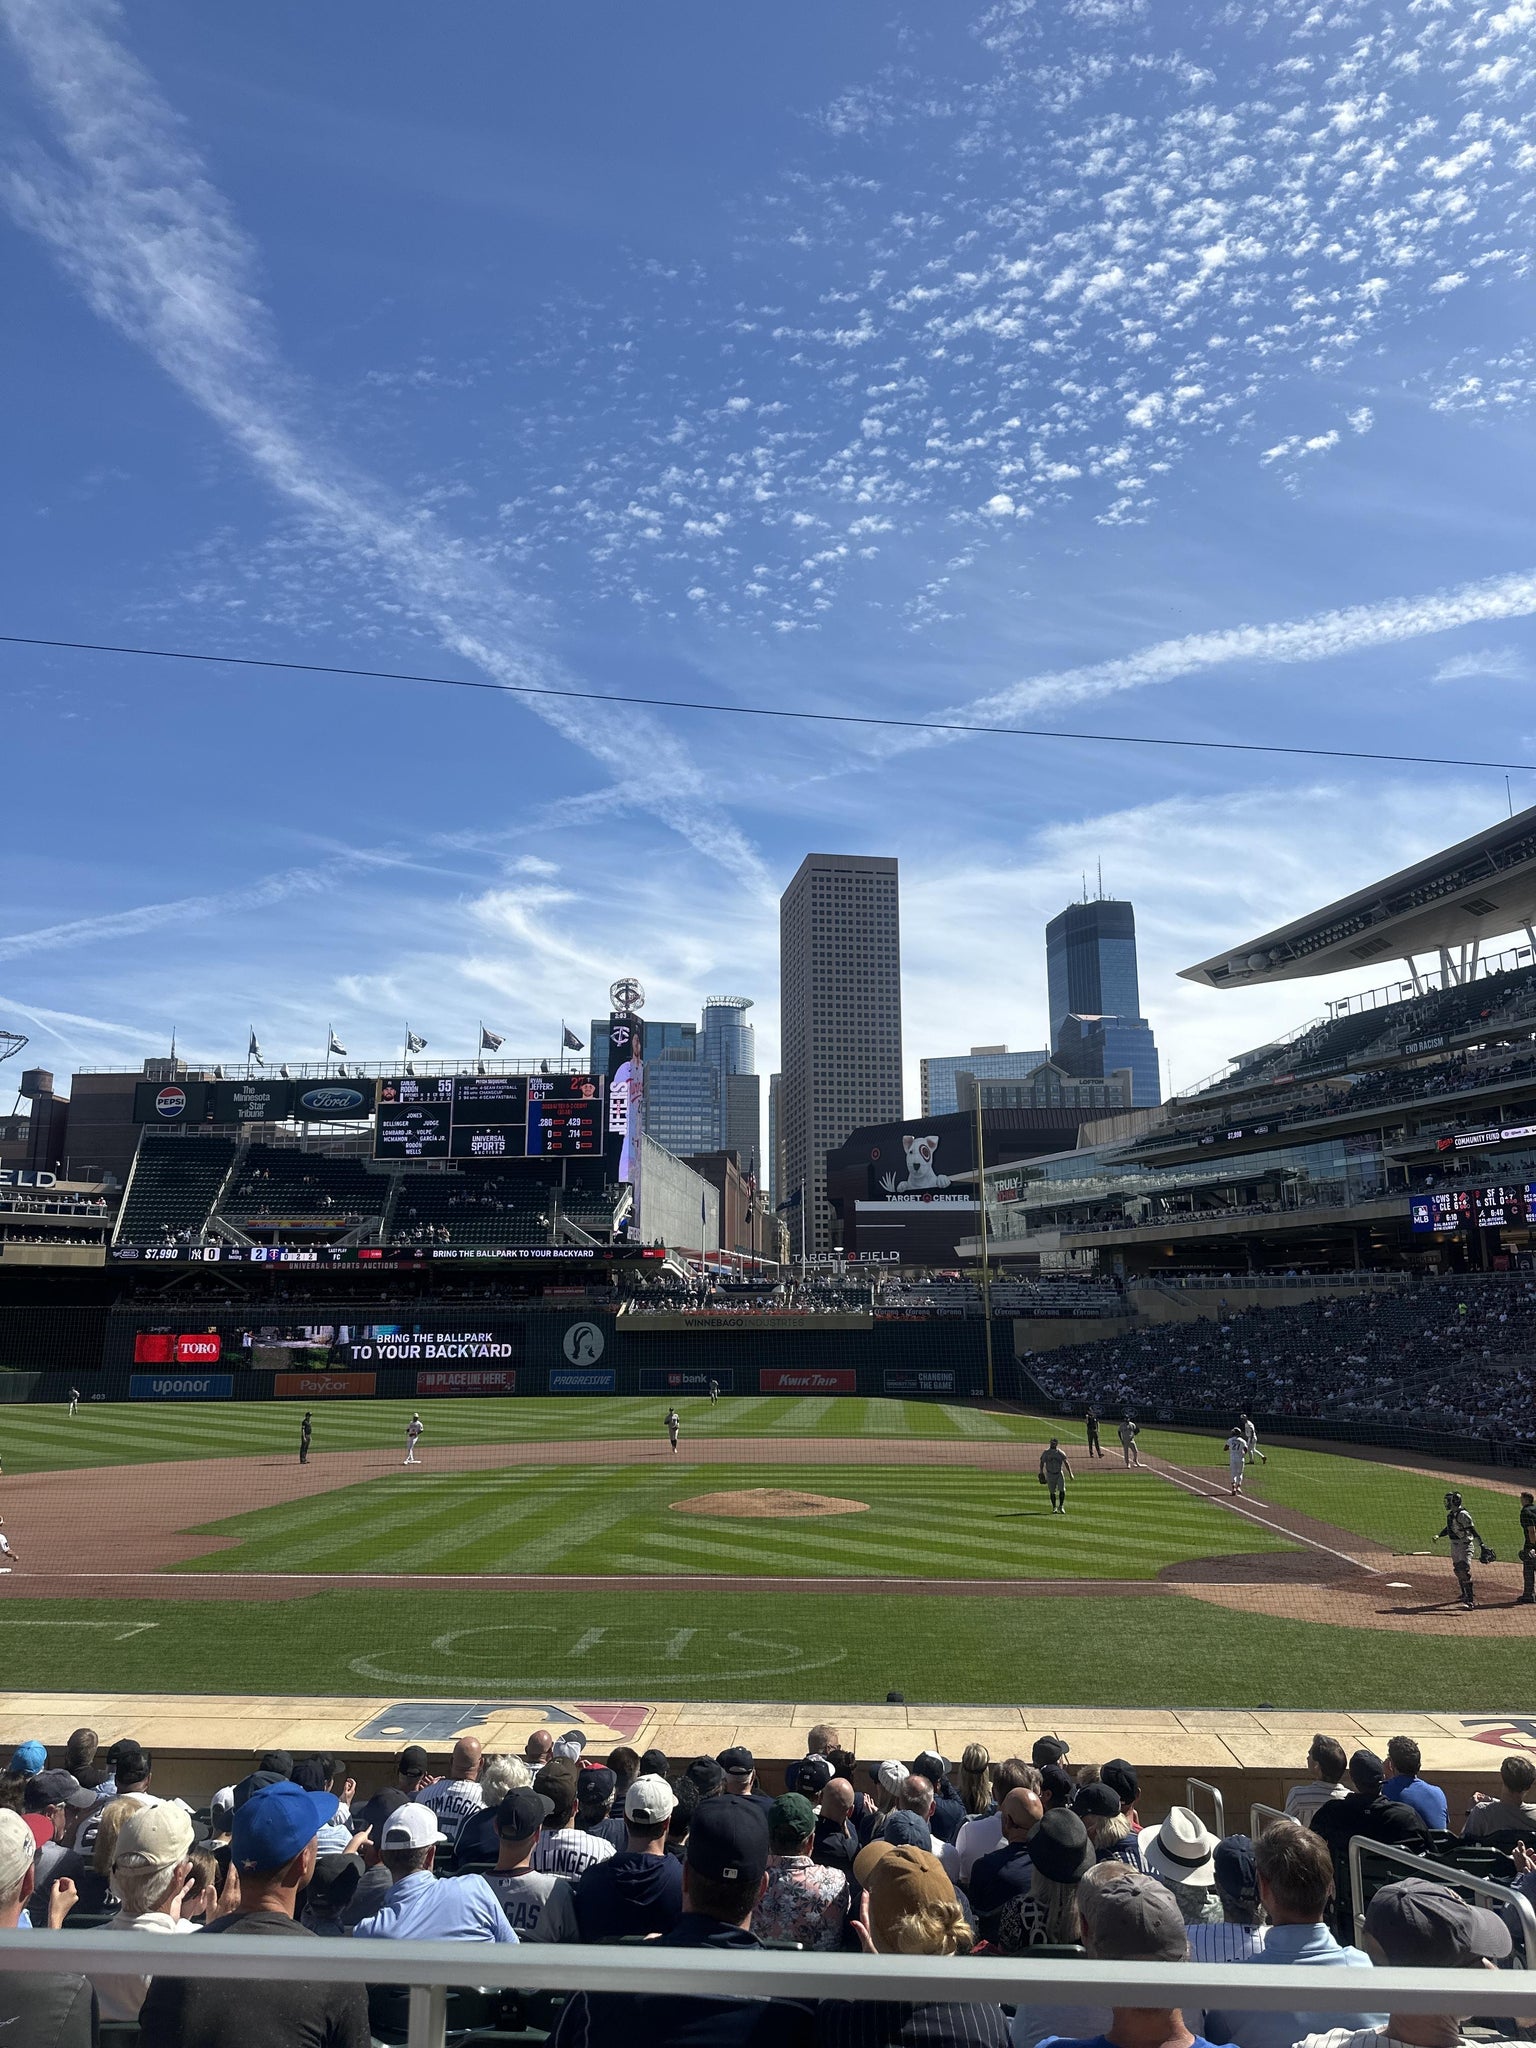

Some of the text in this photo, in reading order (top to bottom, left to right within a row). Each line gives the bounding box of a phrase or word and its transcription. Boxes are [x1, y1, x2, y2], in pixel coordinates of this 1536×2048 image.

[1405, 1037, 1444, 1054] END RACISM
[243, 1086, 256, 1094] The
[438, 1080, 451, 1092] 55
[313, 1091, 350, 1107] Ford
[249, 1102, 265, 1110] Star
[609, 1081, 627, 1135] JEFFERS
[238, 1109, 264, 1118] Tribune
[1455, 1135, 1485, 1146] COMMUNITY
[1486, 1132, 1500, 1141] FUND
[472, 1142, 505, 1151] SPORTS
[994, 1177, 1019, 1190] TRULY
[1436, 1193, 1458, 1203] CWS 3
[1487, 1189, 1495, 1197] SF
[1440, 1202, 1451, 1211] CLE
[1484, 1198, 1496, 1206] STL
[145, 1249, 178, 1260] $7,990
[208, 1249, 215, 1260] 0
[255, 1249, 263, 1260] 2
[793, 1251, 899, 1262] TARGET FIELD
[685, 1318, 804, 1327] WINNEBAGO INDUSTRIES
[182, 1332, 493, 1354] TORO BRING THE BALLPARK
[351, 1343, 512, 1360] TO YOUR BACKYARD
[436, 1374, 467, 1385] PLACE
[482, 1373, 506, 1384] HERE
[553, 1375, 612, 1385] PROGRESSIVE
[669, 1374, 707, 1384] us bank
[153, 1380, 210, 1394] uponor
[301, 1378, 349, 1392] Paycor
